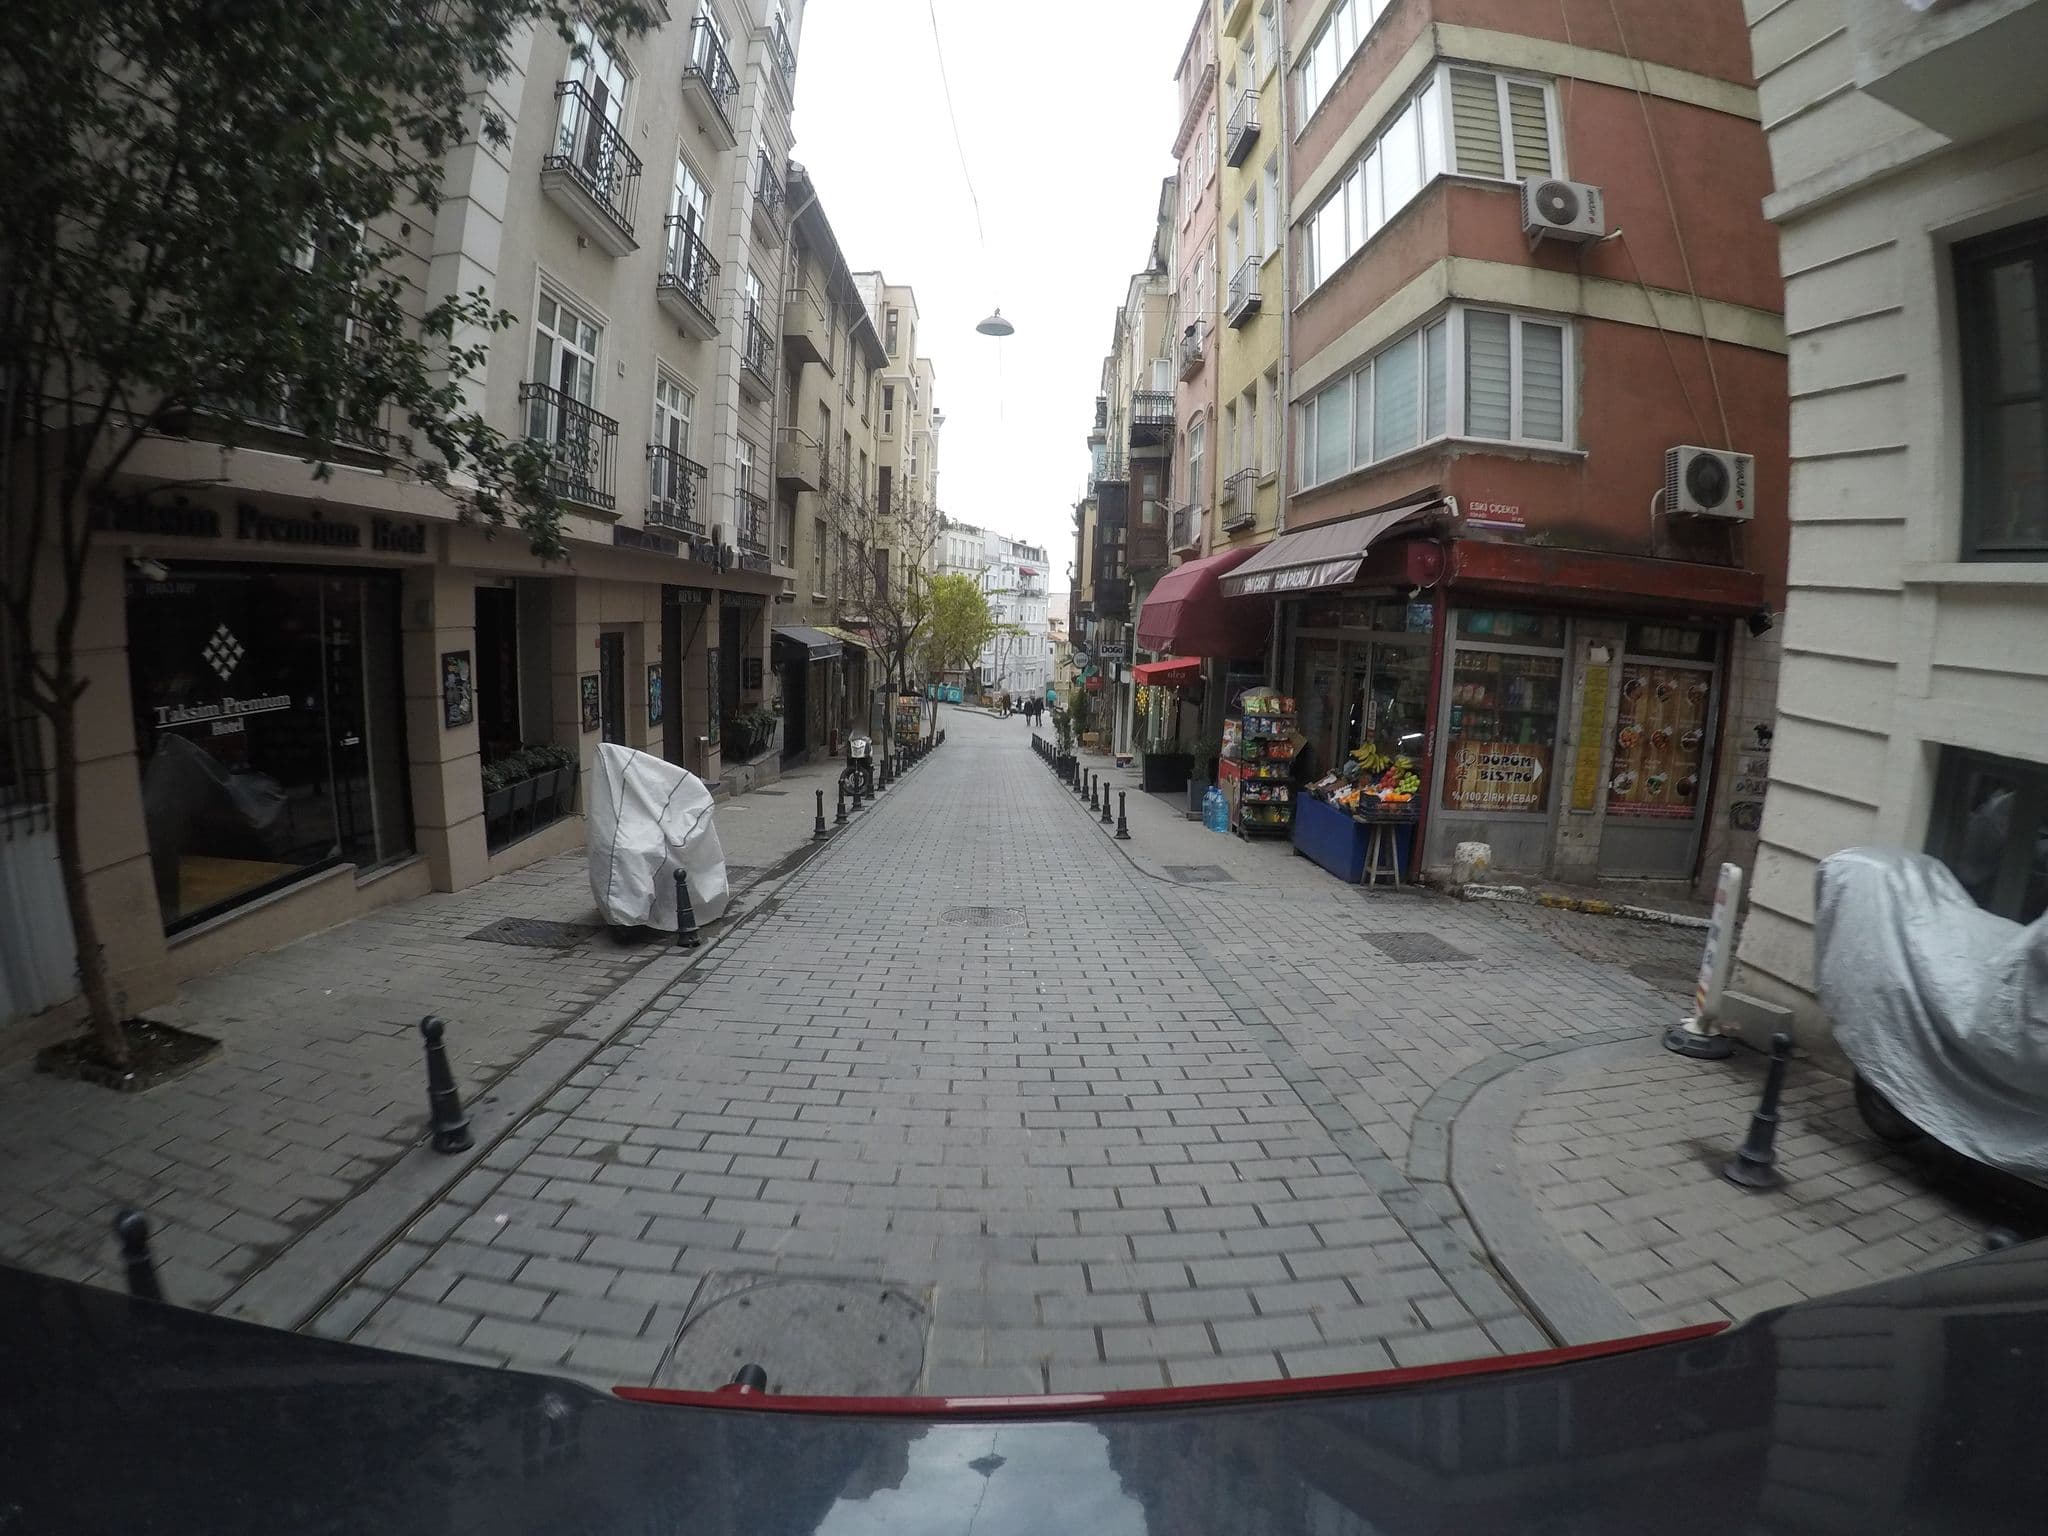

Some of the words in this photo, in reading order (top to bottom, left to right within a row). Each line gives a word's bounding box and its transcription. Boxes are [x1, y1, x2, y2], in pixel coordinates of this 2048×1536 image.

[237, 502, 361, 548] Premium
[373, 517, 426, 554] Hotel
[154, 702, 220, 724] Taksim
[222, 692, 291, 714] Premium
[211, 717, 245, 736] Hotel
[1479, 752, 1533, 768] DÜRÜM
[1479, 768, 1532, 783] BİSTRO
[1506, 792, 1538, 804] KEBAP
